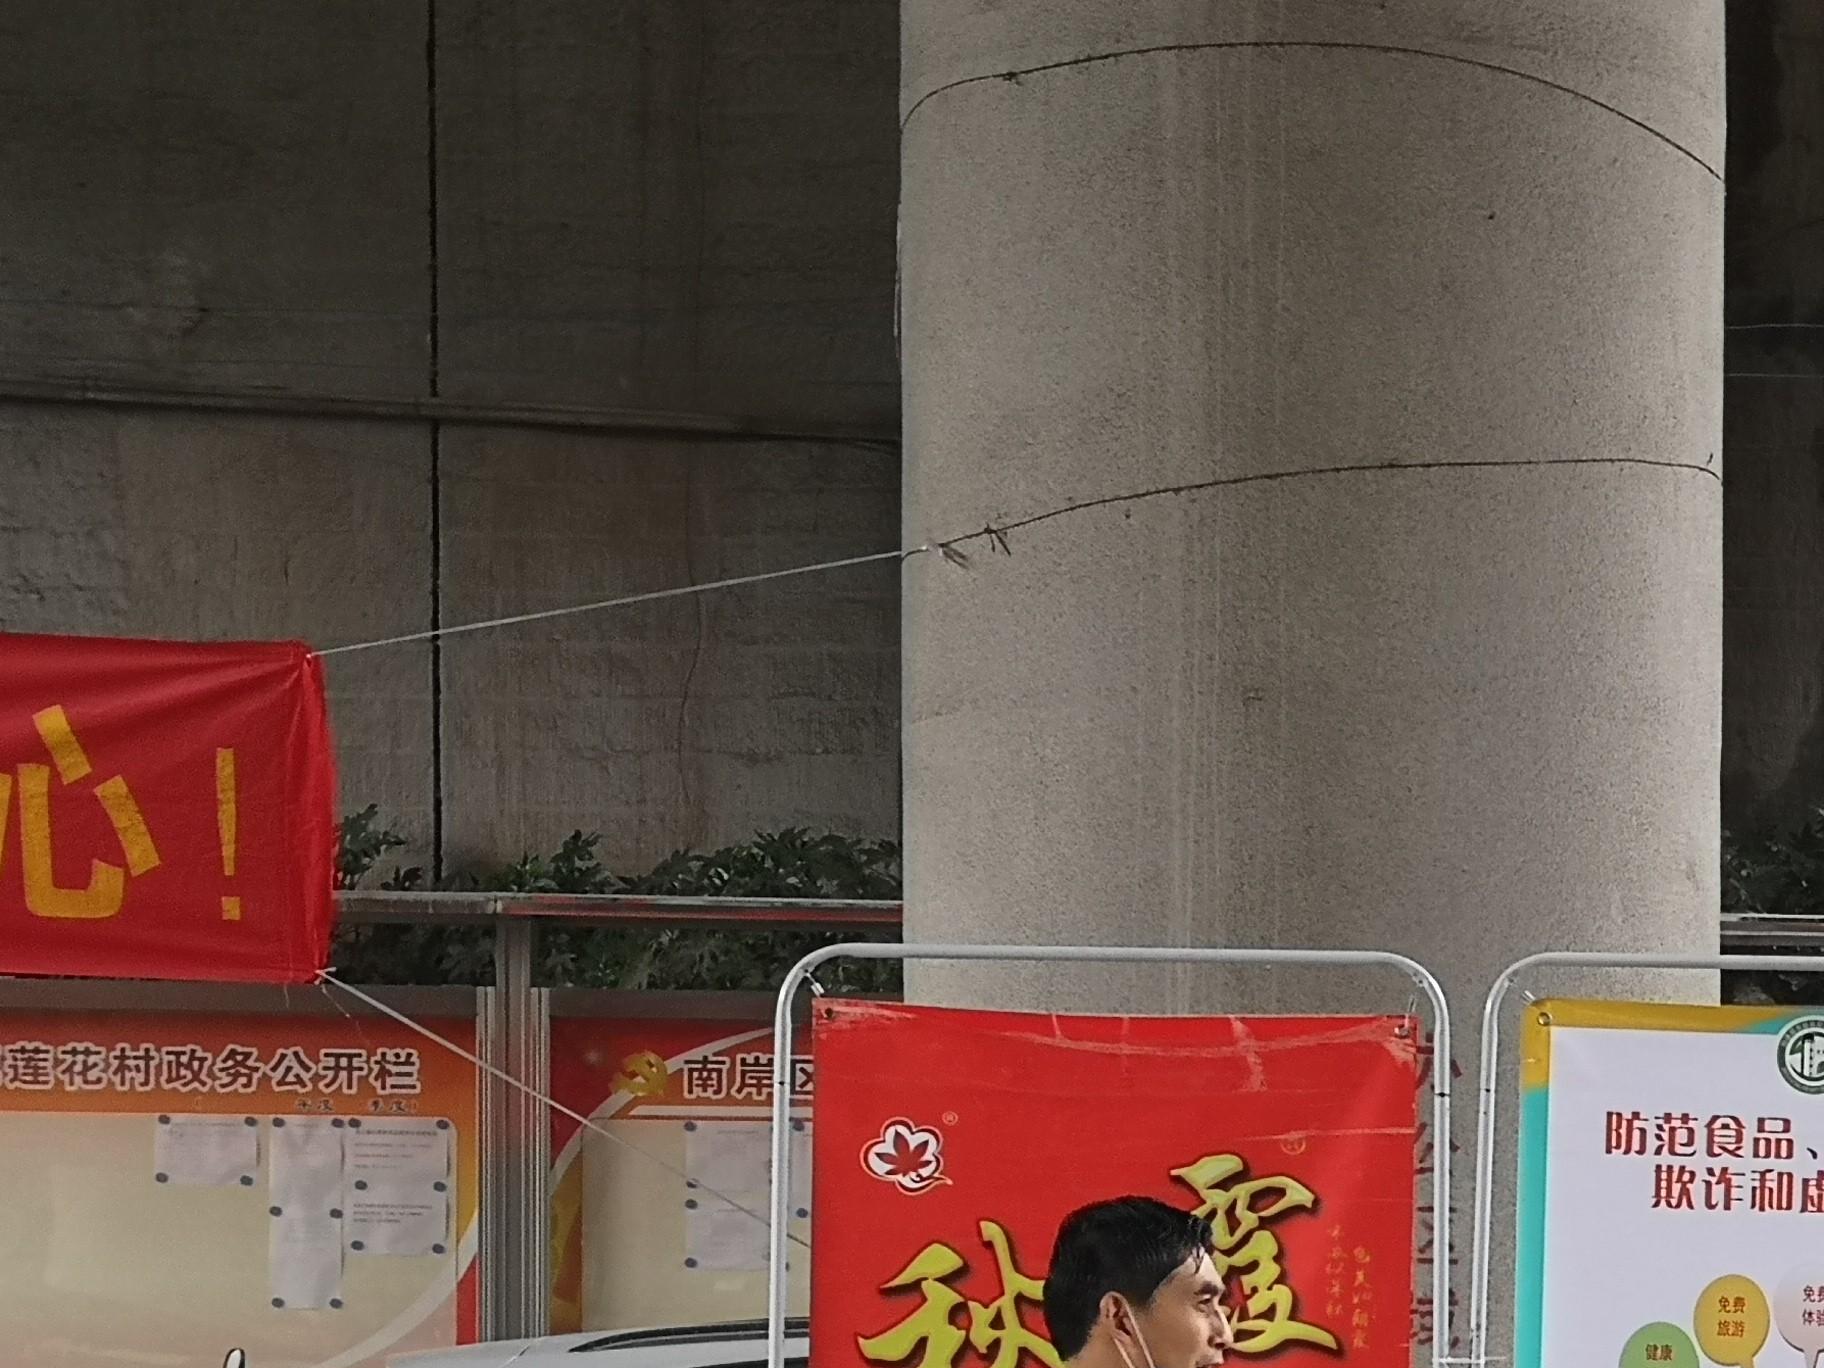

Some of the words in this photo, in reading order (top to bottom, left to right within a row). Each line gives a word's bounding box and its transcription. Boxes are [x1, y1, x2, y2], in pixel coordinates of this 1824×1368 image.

[6, 1042, 421, 1095] 莲花村政务公开栏
[1717, 1296, 1746, 1314] 免费
[1716, 1320, 1746, 1339] 旅游
[1644, 1343, 1673, 1362] 健康
